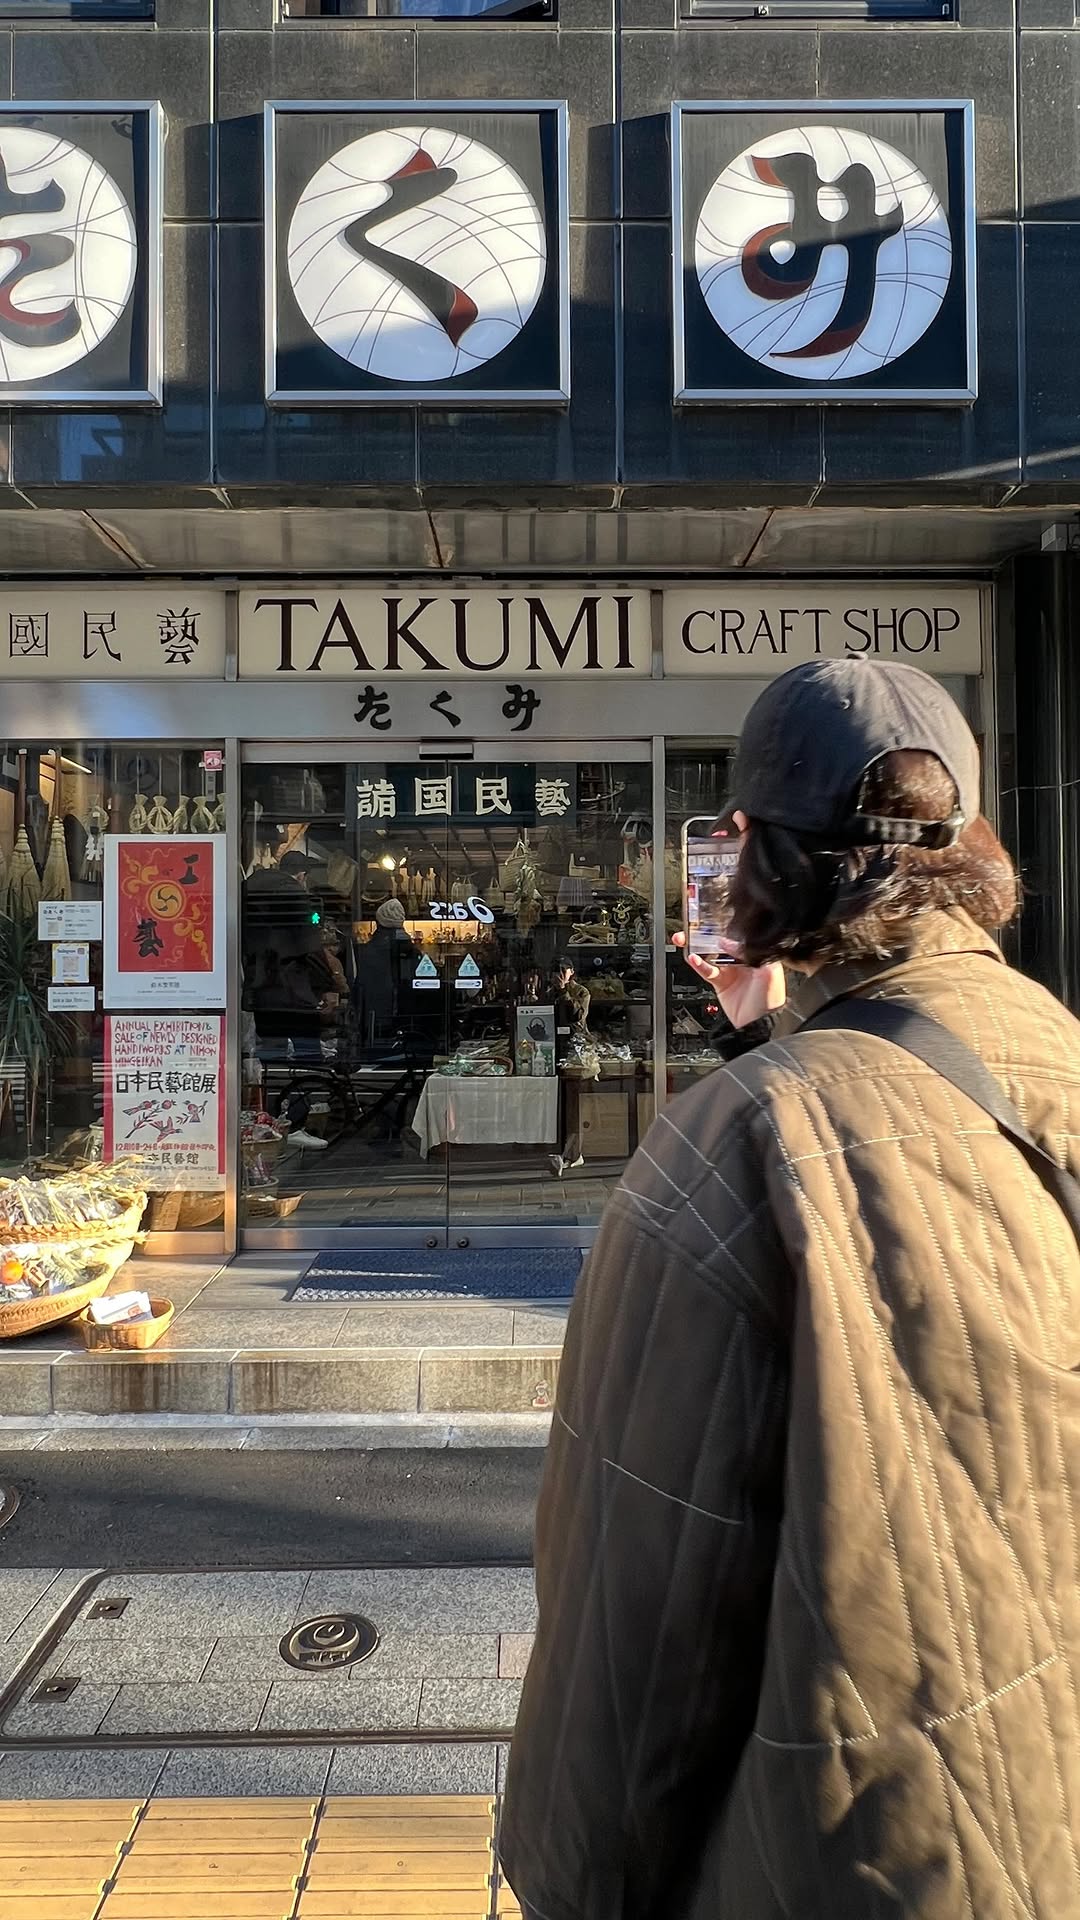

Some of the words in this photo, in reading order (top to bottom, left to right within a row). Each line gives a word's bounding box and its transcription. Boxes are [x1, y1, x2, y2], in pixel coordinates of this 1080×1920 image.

[8, 607, 201, 665] 國民藝
[253, 595, 636, 672] TAKUMI
[681, 608, 832, 655] CRAFT
[843, 607, 961, 653] SHOP
[354, 684, 542, 731] たくみ
[115, 1021, 151, 1032] ANNUAL
[153, 1021, 204, 1032] EXHIBITION
[115, 1032, 135, 1043] SALE
[150, 1032, 177, 1043] NEWLY
[181, 1032, 217, 1045] DESIGNED
[174, 1045, 186, 1055] AT
[189, 1045, 217, 1056] NIHON
[116, 1070, 217, 1094] 日本民藝館展
